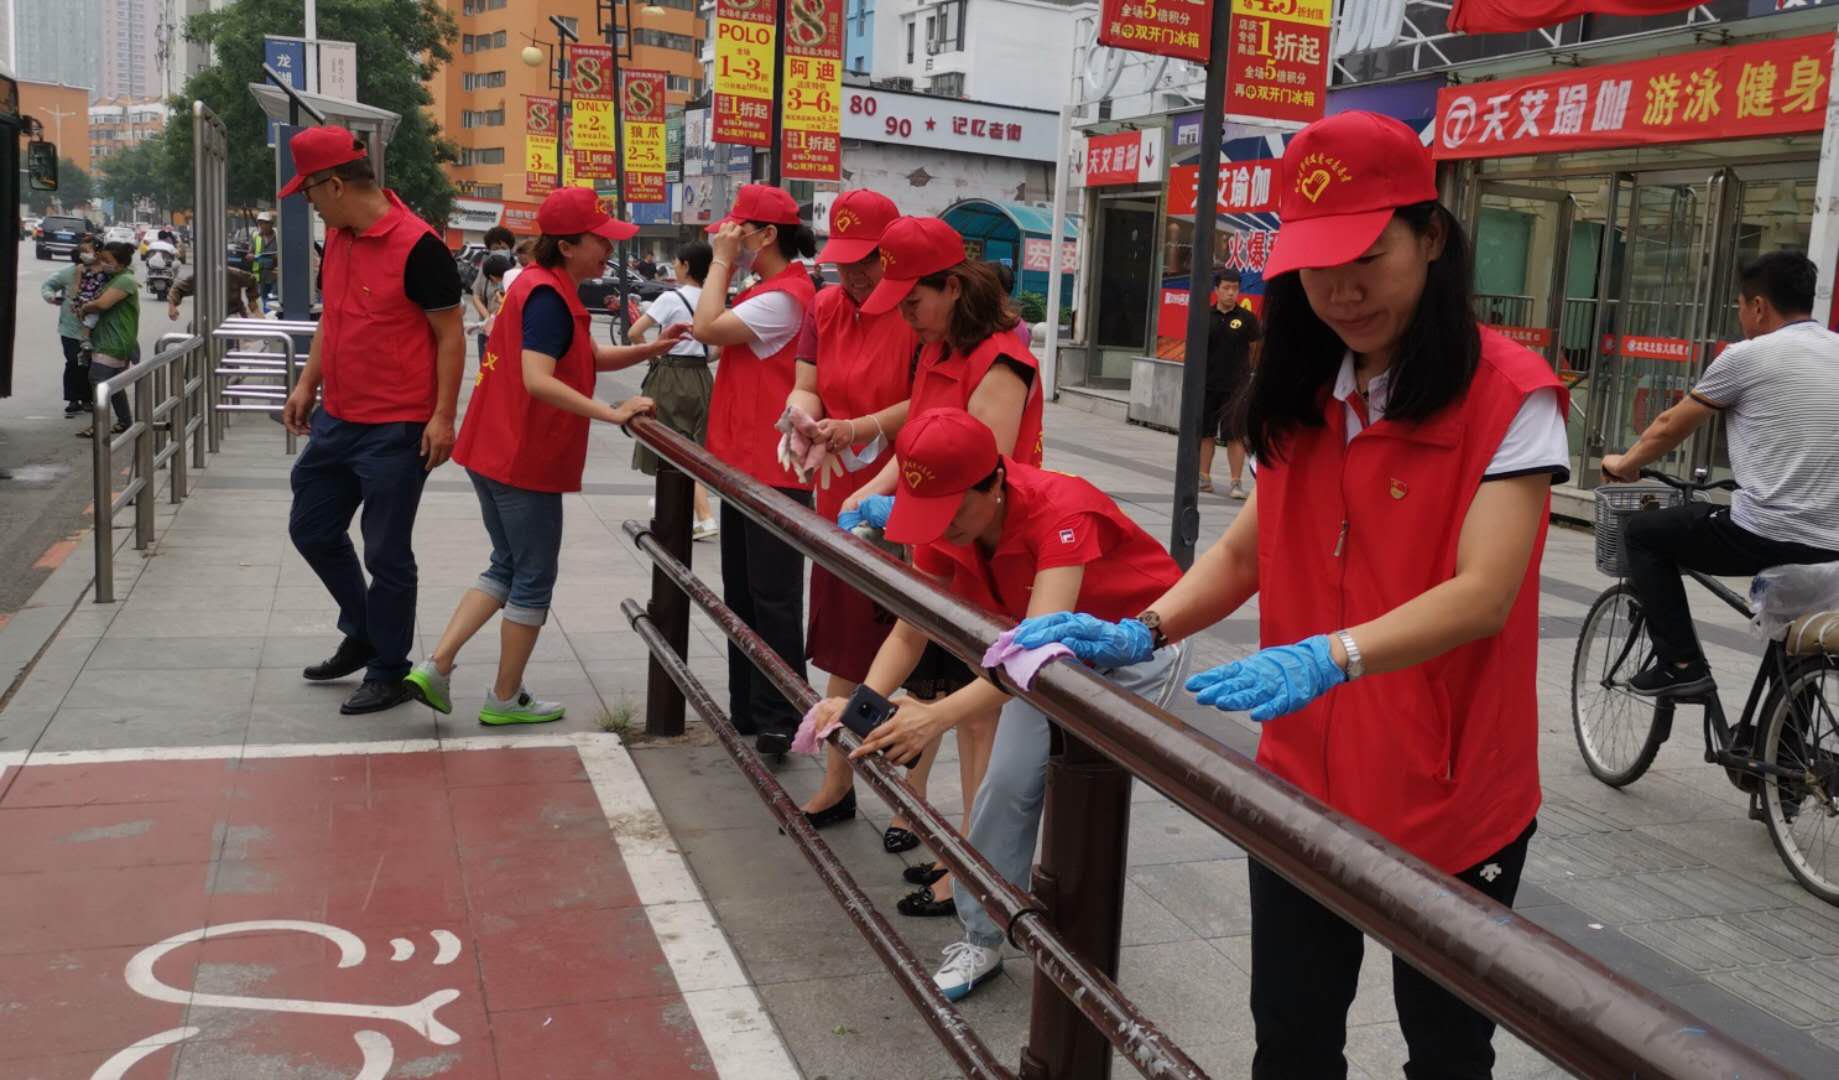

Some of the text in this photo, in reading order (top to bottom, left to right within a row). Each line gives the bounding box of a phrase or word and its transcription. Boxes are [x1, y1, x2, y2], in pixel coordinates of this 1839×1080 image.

[718, 23, 770, 45] POLO
[790, 59, 836, 82] 阿迪
[576, 101, 610, 113] ONLY
[849, 95, 877, 117] 80
[1479, 55, 1826, 144] 天艾瑜伽 游泳 健身
[885, 116, 1023, 142] 90 记忆老街
